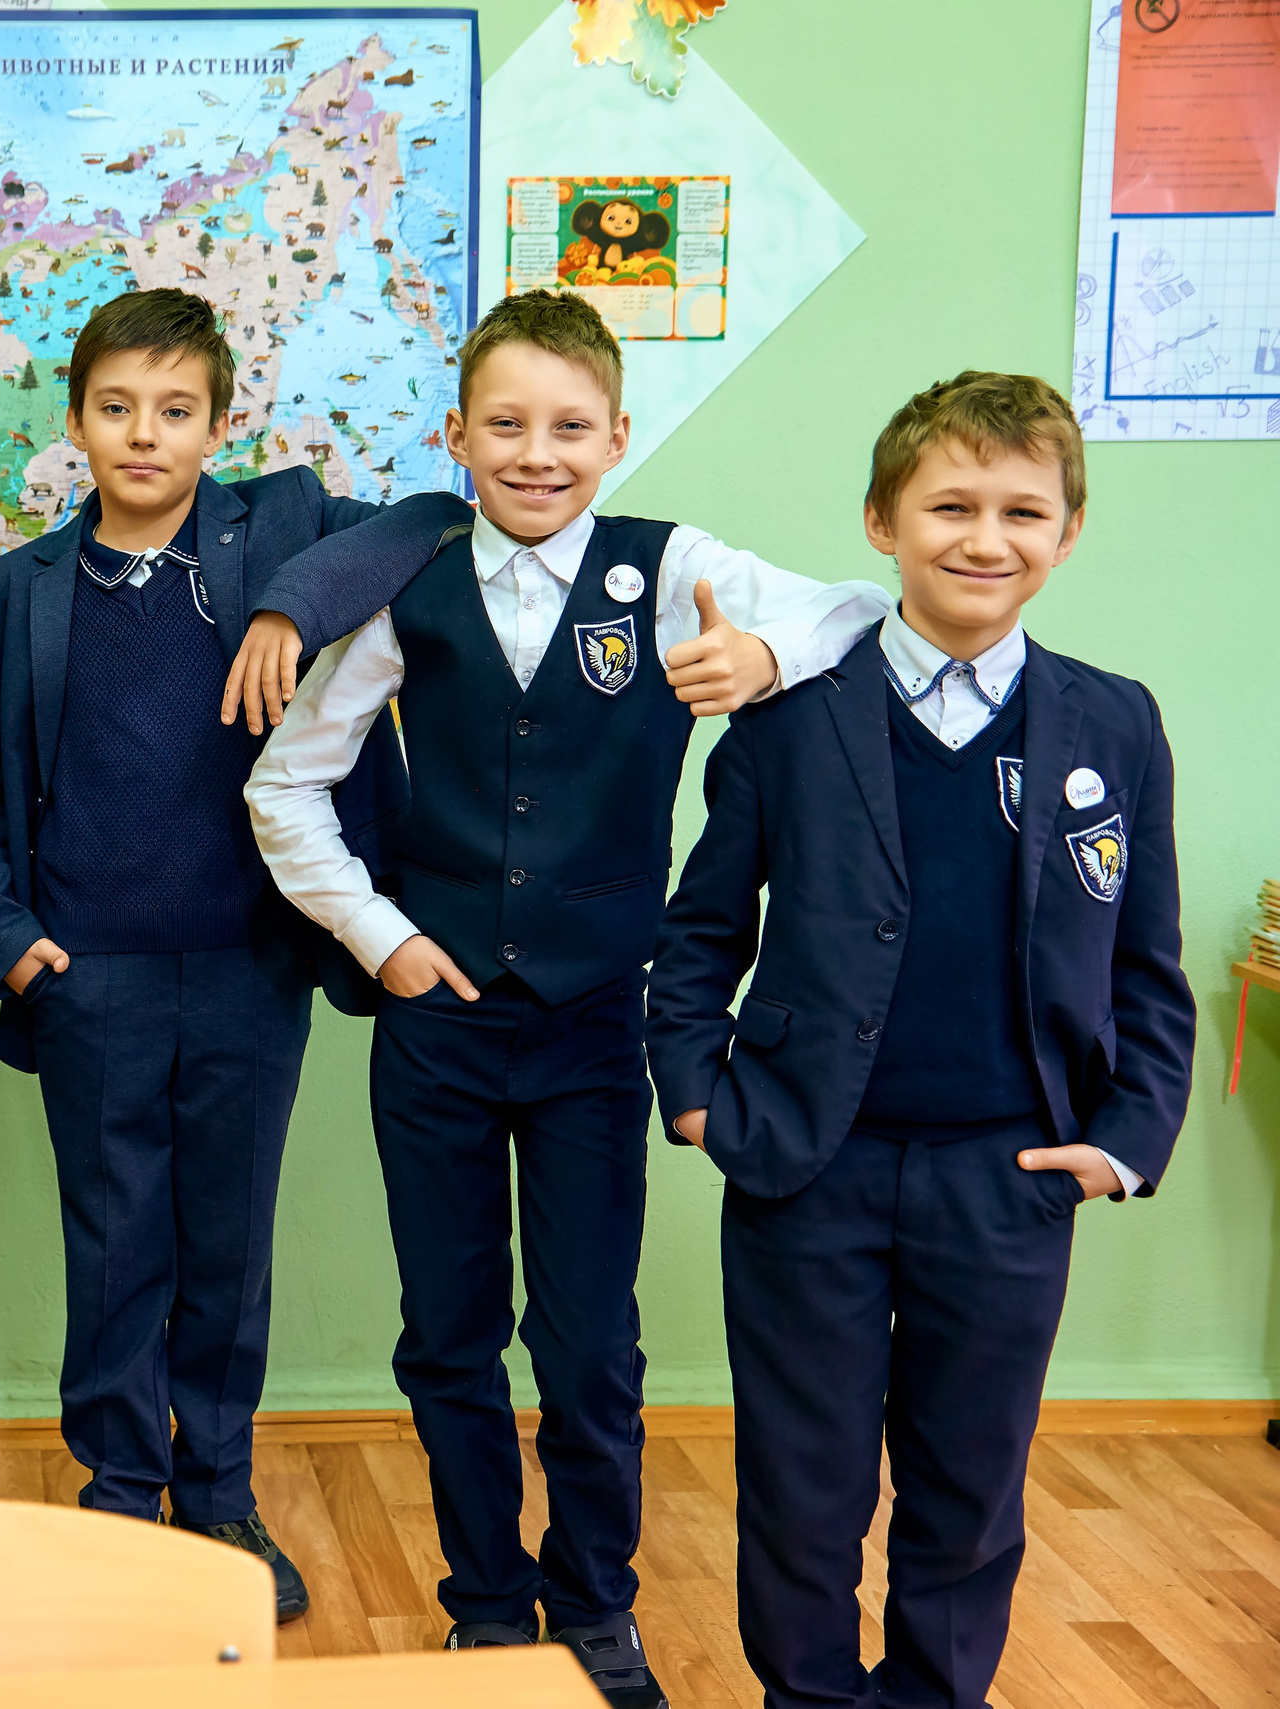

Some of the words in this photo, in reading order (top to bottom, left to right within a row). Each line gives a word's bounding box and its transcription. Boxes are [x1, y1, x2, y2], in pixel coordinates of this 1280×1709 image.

[130, 58, 147, 76] И
[155, 57, 286, 76] РАСТЕНИЯ
[1143, 345, 1231, 405] English
[593, 627, 632, 643] ЛАВРОВСКАЯ
